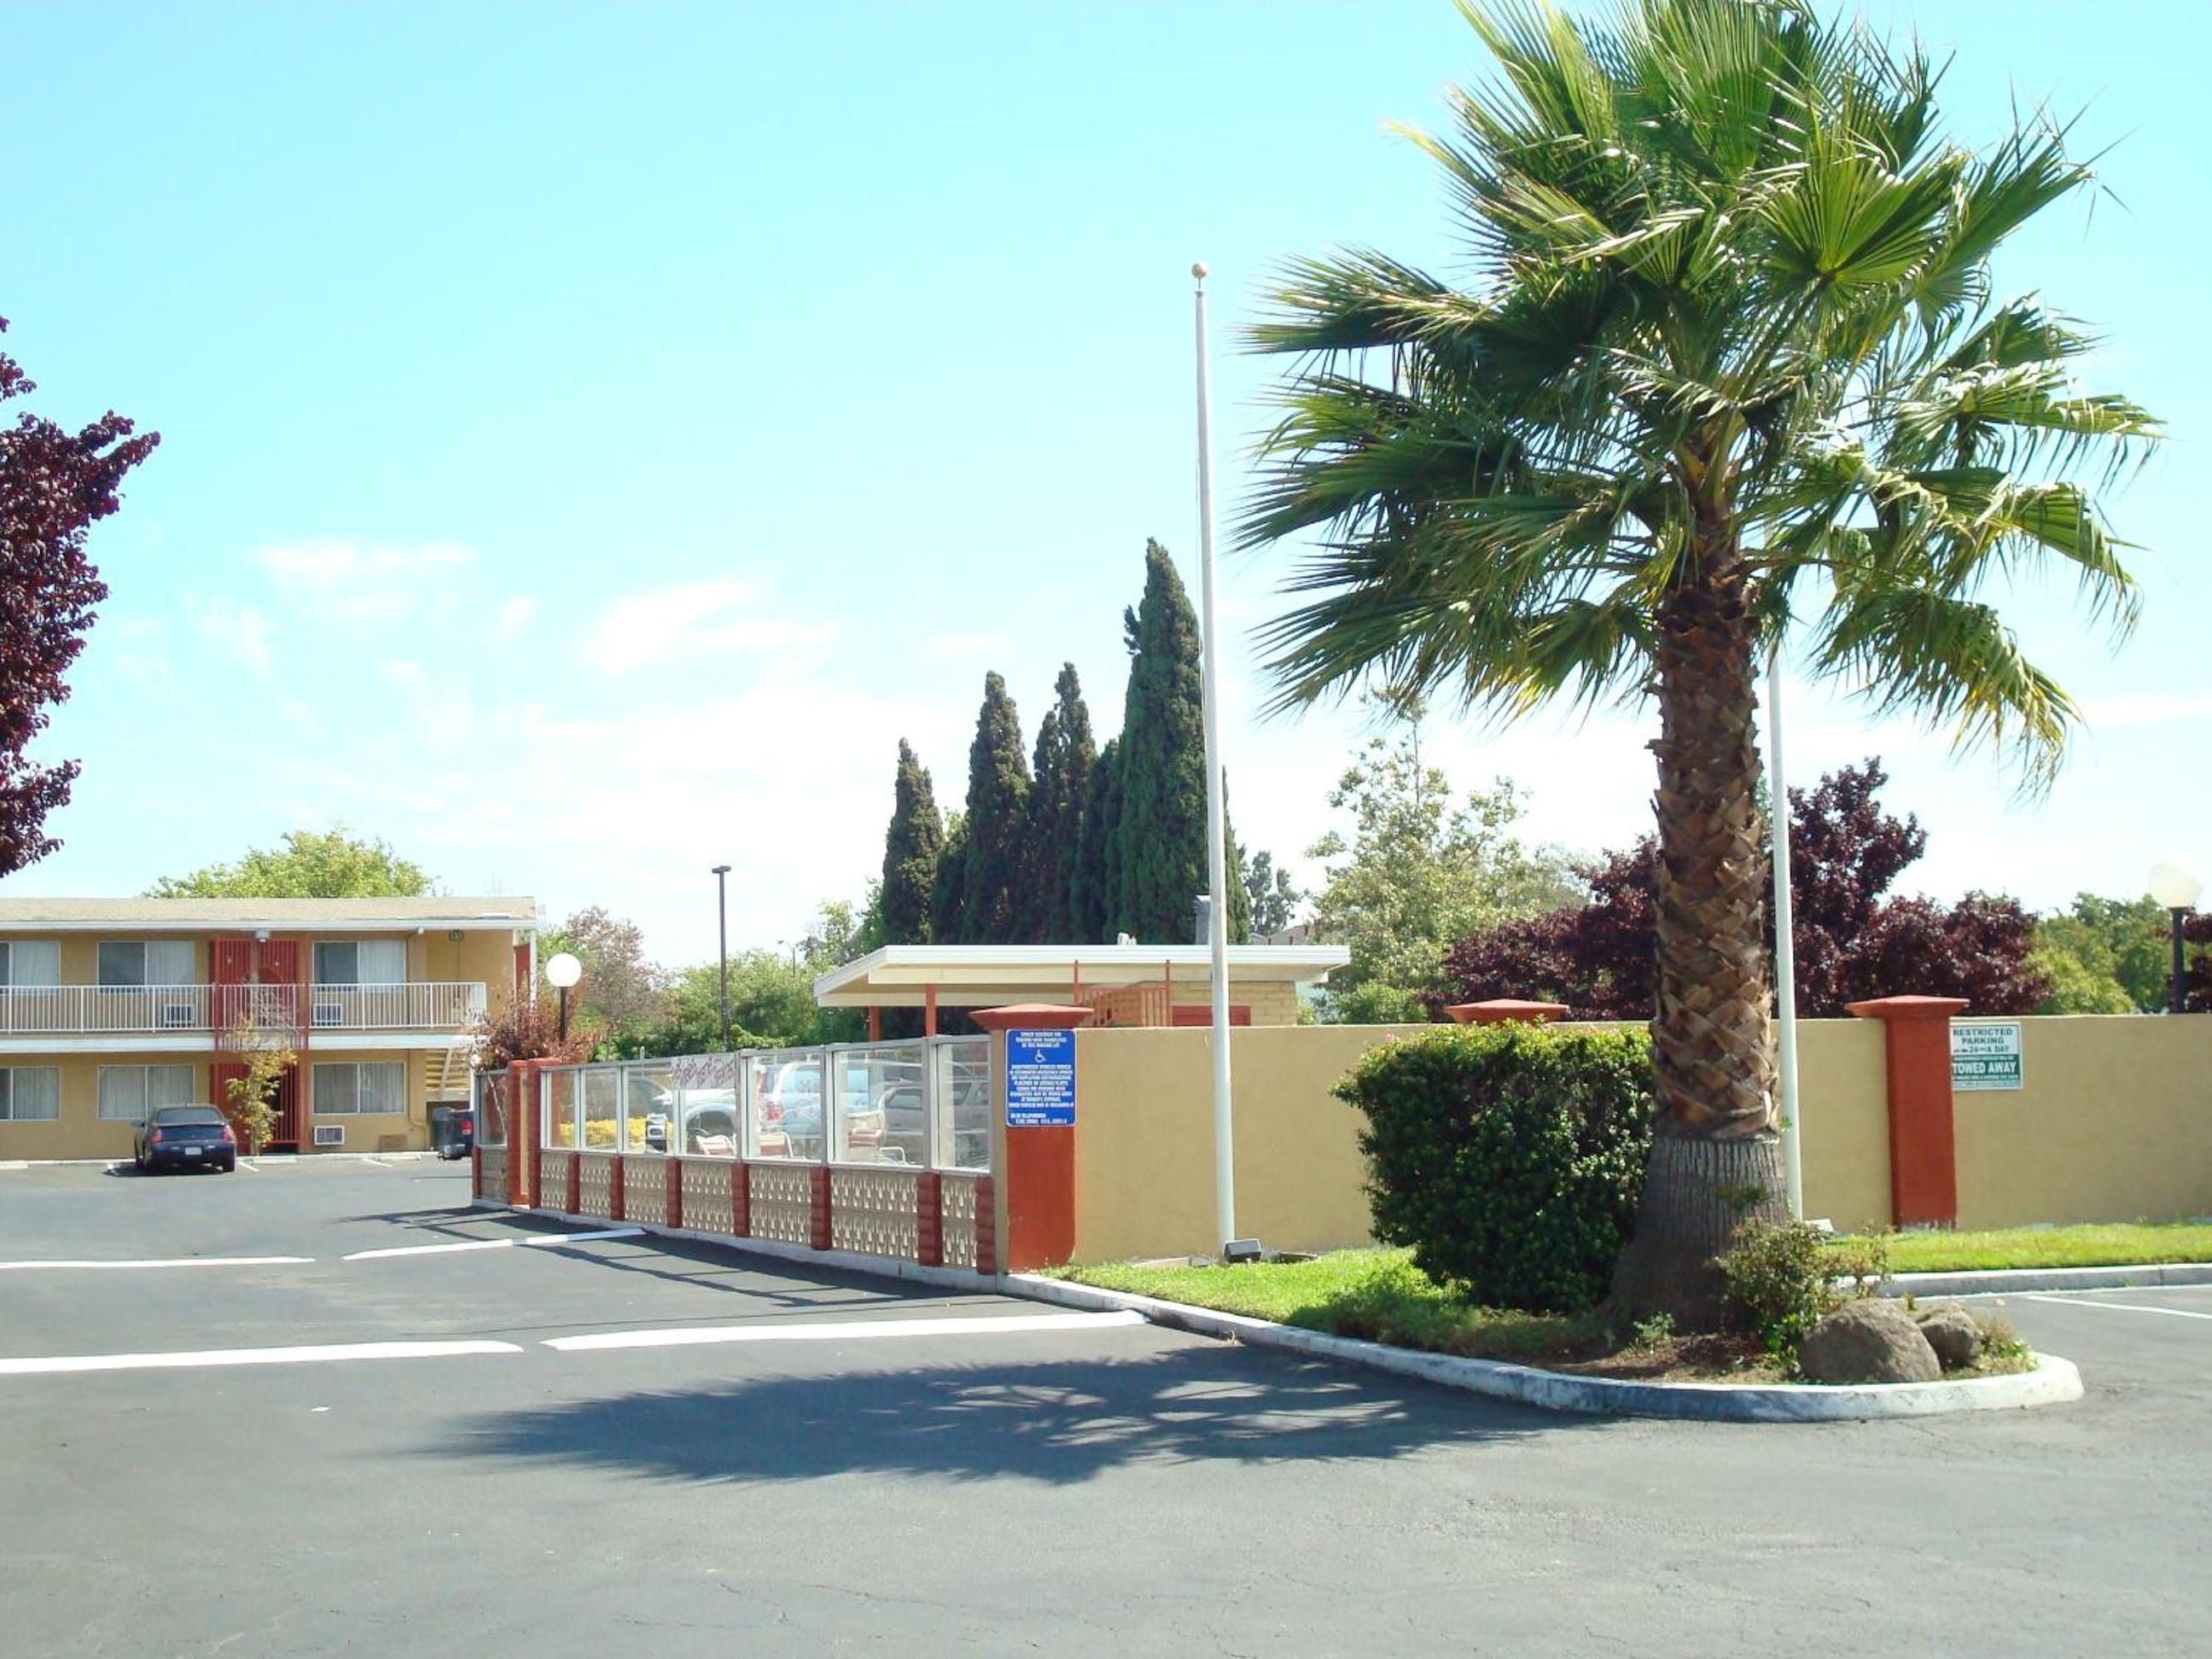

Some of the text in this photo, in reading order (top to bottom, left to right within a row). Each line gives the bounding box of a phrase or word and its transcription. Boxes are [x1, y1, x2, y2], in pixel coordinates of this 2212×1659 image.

[1953, 1027, 2012, 1036] RESTRICTED
[1952, 1061, 2017, 1074] TOWED AWAY
